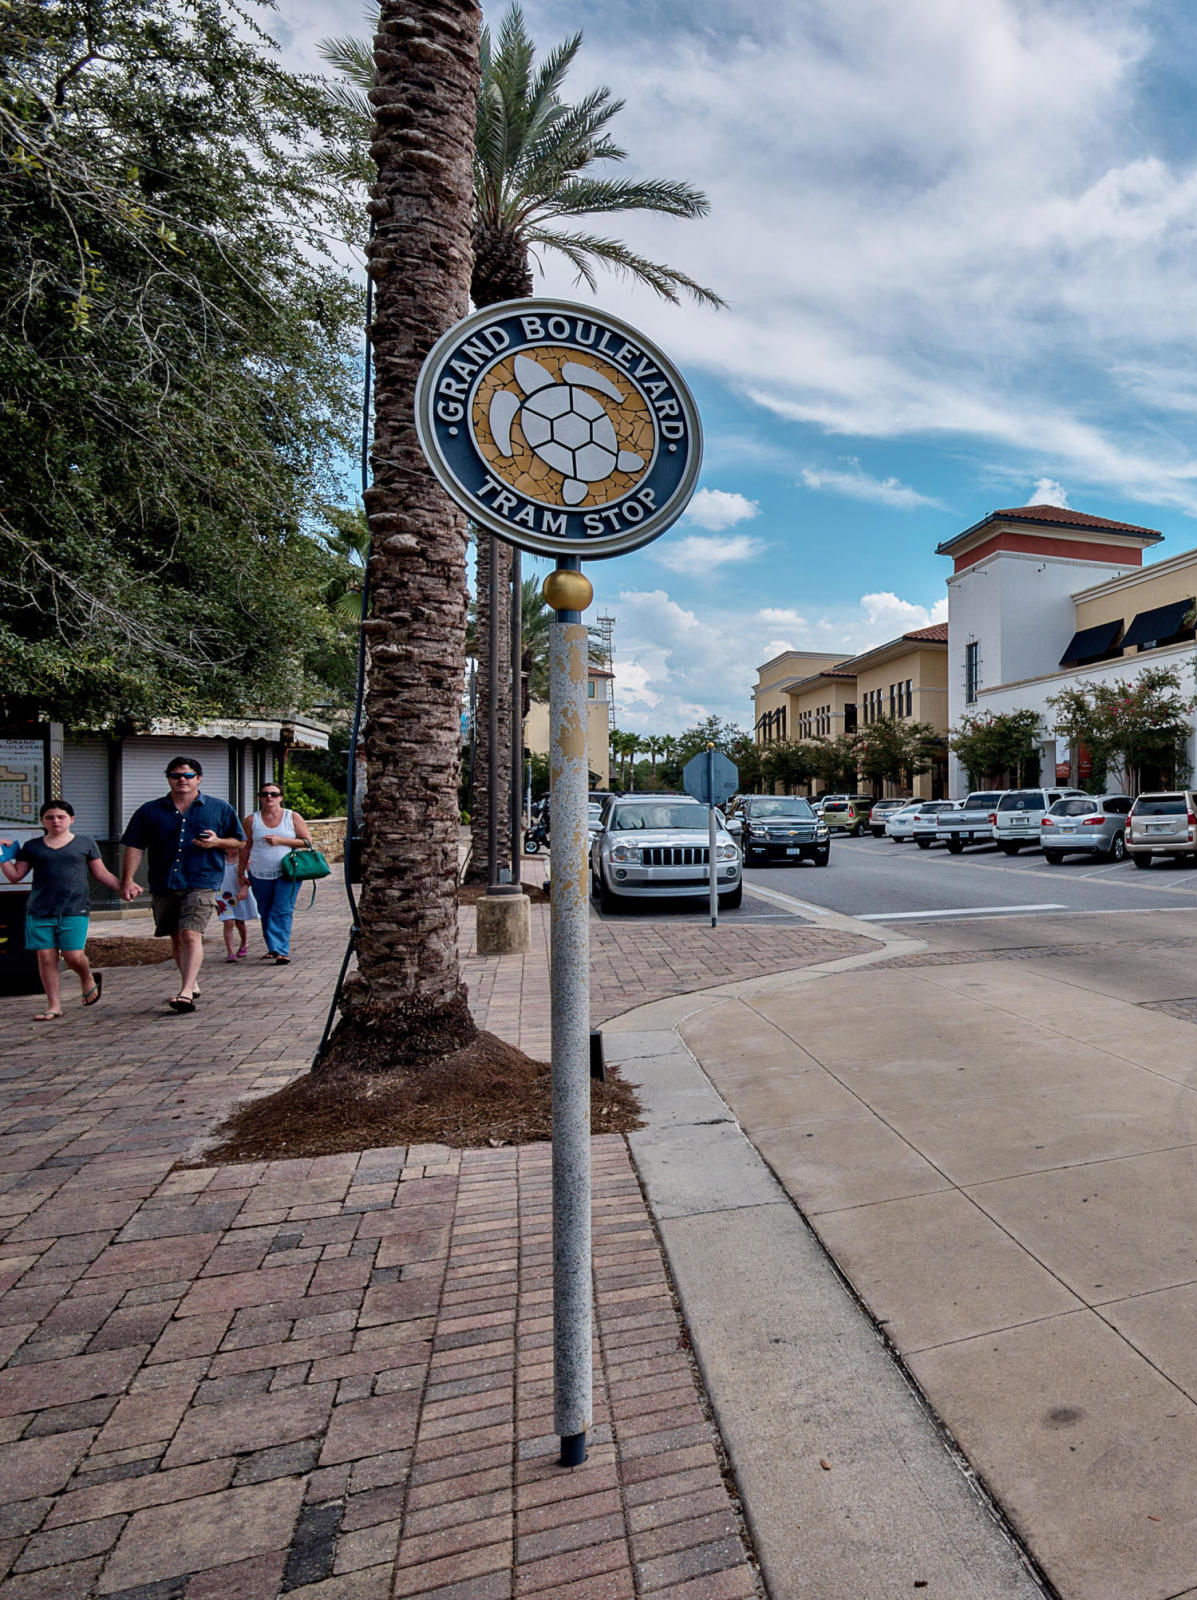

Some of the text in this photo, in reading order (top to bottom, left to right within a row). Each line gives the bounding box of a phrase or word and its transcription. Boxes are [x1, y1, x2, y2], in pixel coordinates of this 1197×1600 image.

[437, 316, 685, 440] GRAND BOULEVARD
[475, 474, 657, 536] TRAM STOP
